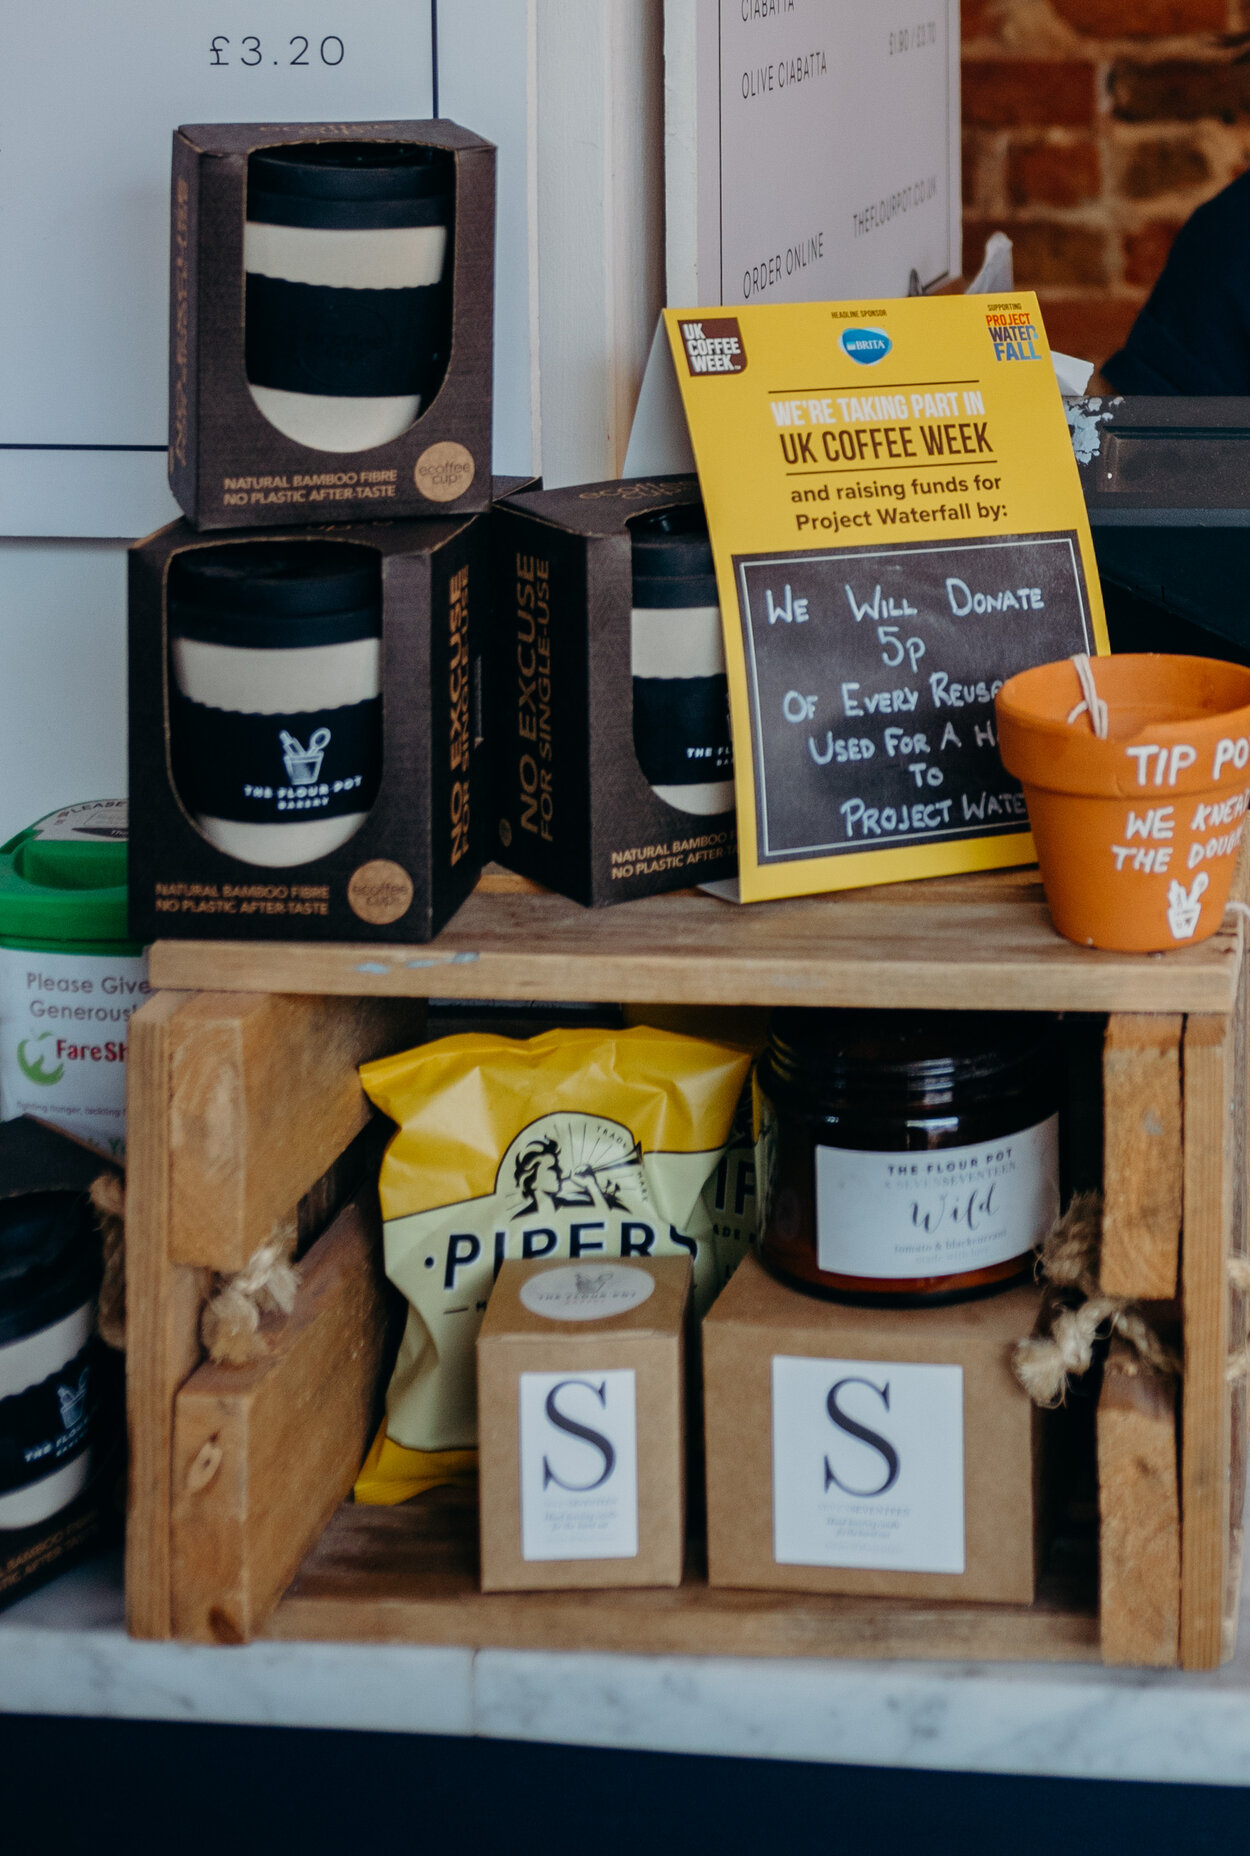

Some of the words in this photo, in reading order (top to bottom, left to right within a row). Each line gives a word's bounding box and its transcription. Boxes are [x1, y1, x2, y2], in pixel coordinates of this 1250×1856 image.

[209, 35, 345, 67] £3.20
[742, 64, 774, 100] OLIVE
[778, 51, 827, 89] CIABATTA
[743, 255, 782, 300] ORDER
[785, 232, 824, 277] ONLINE
[831, 310, 859, 320] HEADLINE
[860, 308, 888, 319] SPONSOR
[985, 312, 1031, 326] PROJECT
[986, 302, 1022, 312] SUPPORTING
[683, 323, 706, 340] UK
[687, 337, 741, 356] COFFEE
[855, 339, 886, 351] BRITA
[993, 341, 1042, 362] FALL
[770, 398, 837, 427] WE'RE
[840, 394, 909, 423] TAKING
[911, 391, 959, 420] PART
[962, 390, 986, 417] IN
[779, 431, 817, 465] UK
[821, 425, 914, 463] COFFEE
[919, 422, 994, 459] WEEK
[223, 475, 291, 492] NATURAL
[293, 471, 358, 489] BAMBOO
[360, 469, 399, 484] FIBRE
[431, 473, 459, 486] cup
[790, 483, 830, 504] and
[836, 479, 906, 502] raising
[911, 475, 970, 496] funds
[974, 473, 1003, 492] for
[223, 492, 248, 507] NO
[249, 488, 307, 505] PLASTIC
[309, 484, 397, 503] AFTER-TASTE
[795, 512, 873, 534] Project
[876, 503, 972, 526] Waterfall
[978, 502, 1009, 522] by:
[516, 552, 537, 741] EXCUSE
[535, 559, 553, 760] SINGLE-USE
[449, 574, 463, 772] EXCUSE
[929, 671, 1003, 709] REUSA
[940, 721, 962, 751] A
[687, 746, 713, 759] THE
[1125, 745, 1197, 787] TIP
[244, 784, 273, 799] THE
[277, 782, 330, 799] FLOUR
[333, 774, 363, 793] POT
[519, 751, 540, 834] NO
[460, 778, 471, 854] FOR
[537, 771, 553, 842] FOR
[962, 791, 1028, 821] WATE
[449, 780, 463, 868] NO
[1125, 805, 1176, 841] WE
[611, 841, 670, 866] NATURAL
[671, 832, 728, 854] BAMBOO
[1112, 844, 1174, 874] THE
[611, 864, 633, 880] NO
[635, 855, 684, 876] PLASTIC
[155, 882, 219, 898] NATURAL
[222, 883, 288, 899] BAMBOO
[290, 885, 330, 900] FIBRE
[155, 898, 180, 913] NO
[181, 899, 237, 915] PLASTIC
[239, 900, 329, 916] AFTER-TASTE
[26, 971, 94, 995] Please
[100, 976, 152, 995] Give
[55, 1039, 128, 1063] FareSh
[887, 1165, 918, 1176] THE
[926, 1157, 979, 1175] FLOUR
[985, 1147, 1013, 1165] POT
[909, 1181, 1002, 1234] Wild
[542, 1379, 617, 1492] S
[822, 1376, 900, 1498] S
